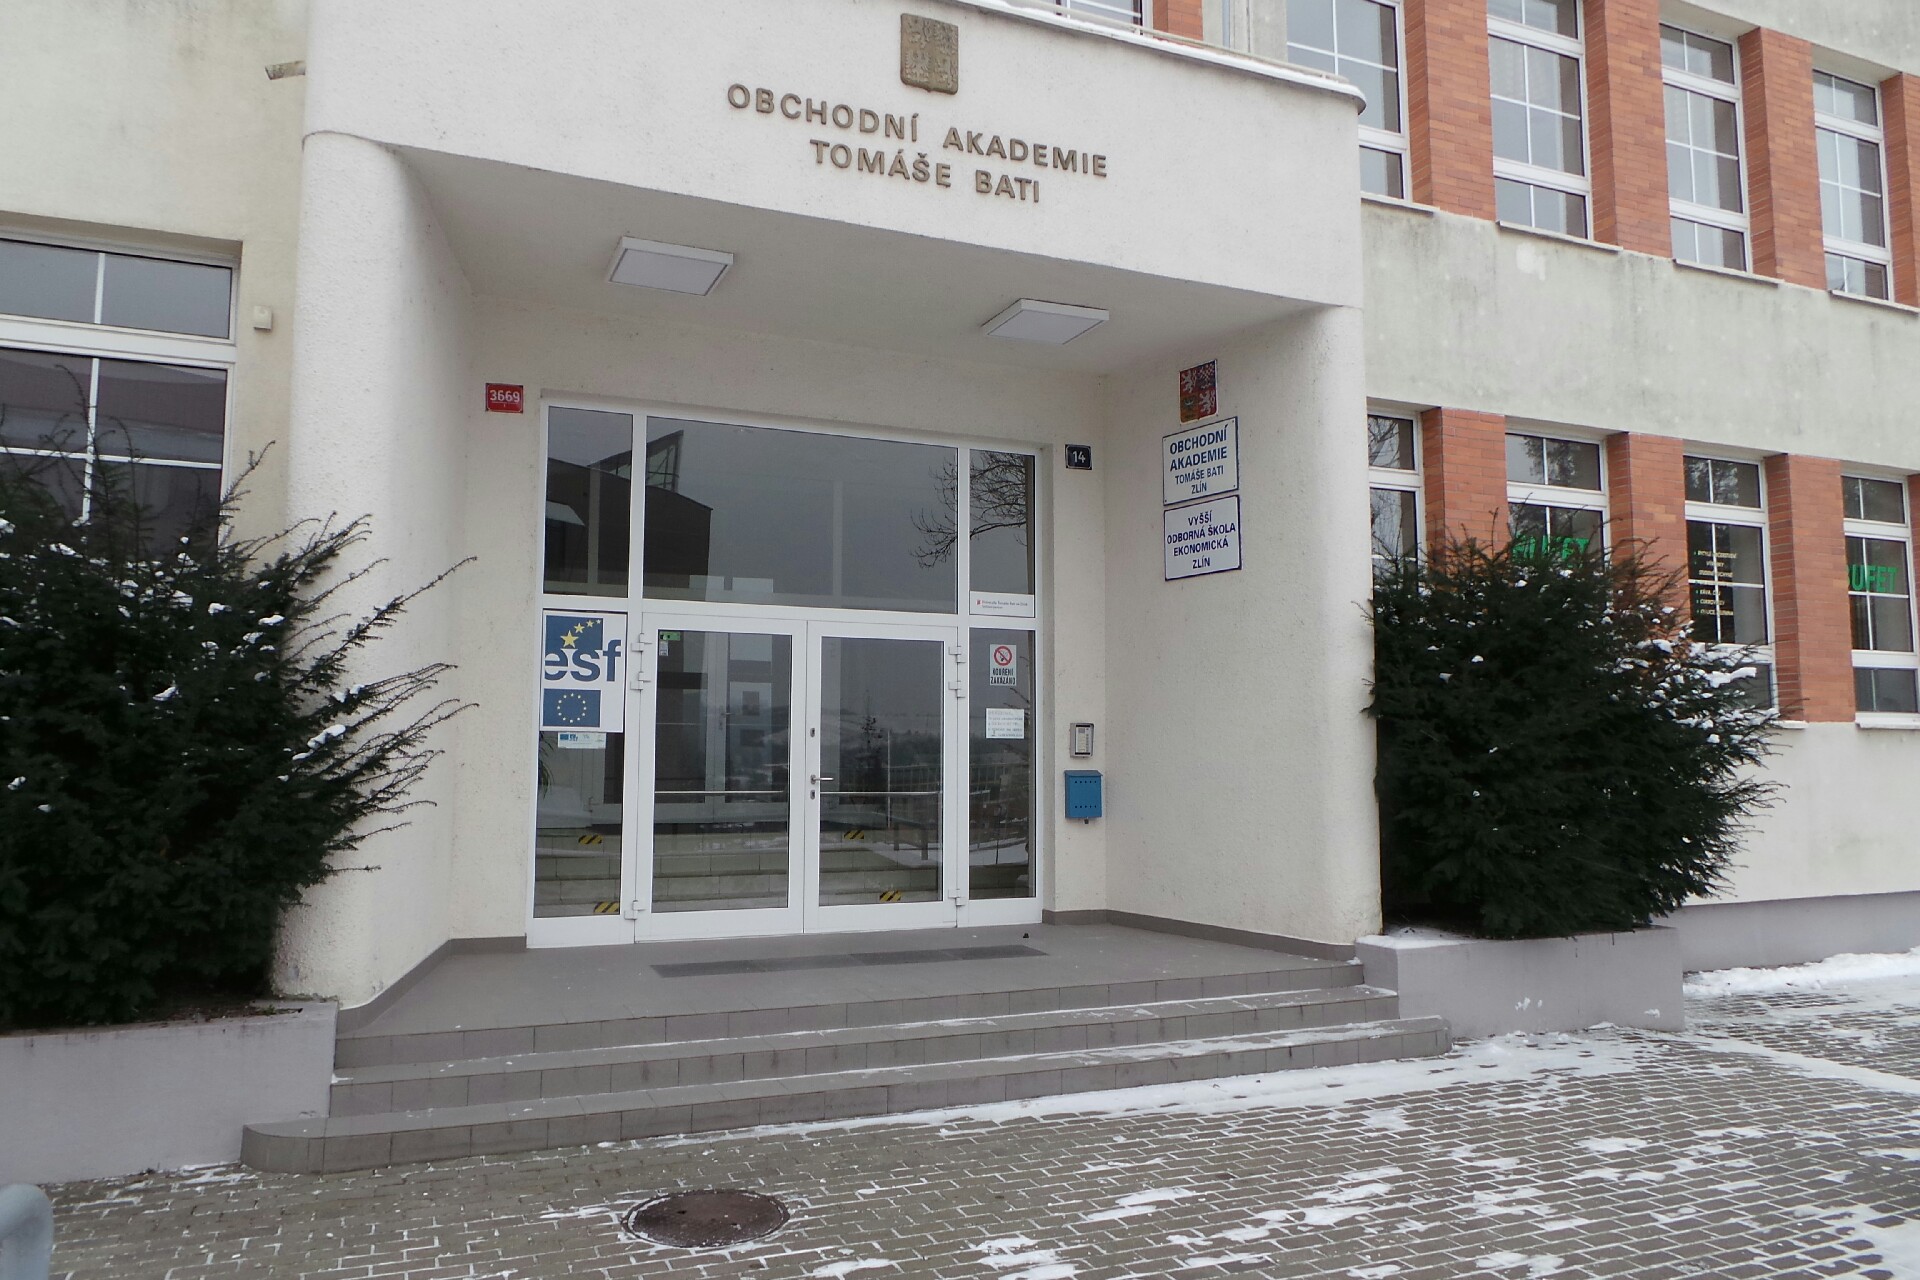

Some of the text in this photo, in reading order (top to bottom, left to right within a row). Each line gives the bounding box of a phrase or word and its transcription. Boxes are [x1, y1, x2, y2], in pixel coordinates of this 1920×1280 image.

[727, 83, 1108, 178] OBCHODNÍ AKADEMIE
[809, 138, 1040, 203] TOMÁŠE BATI
[490, 389, 520, 403] 3669
[1169, 423, 1229, 455] OBCHODNÍ
[1072, 450, 1086, 464] 14
[1169, 446, 1228, 472] AKADEMIE
[1174, 464, 1224, 485] TOMÁŠE BATI
[1191, 480, 1207, 495] ZLÍN
[1188, 510, 1212, 526] VYŠŠÍ
[1166, 522, 1236, 545] ODBORNÁ ŠKOLA
[1173, 535, 1229, 557] EKONOMICKÁ
[1192, 555, 1211, 570] ZLÍN
[1846, 564, 1898, 593] UFET
[544, 639, 622, 682] esf
